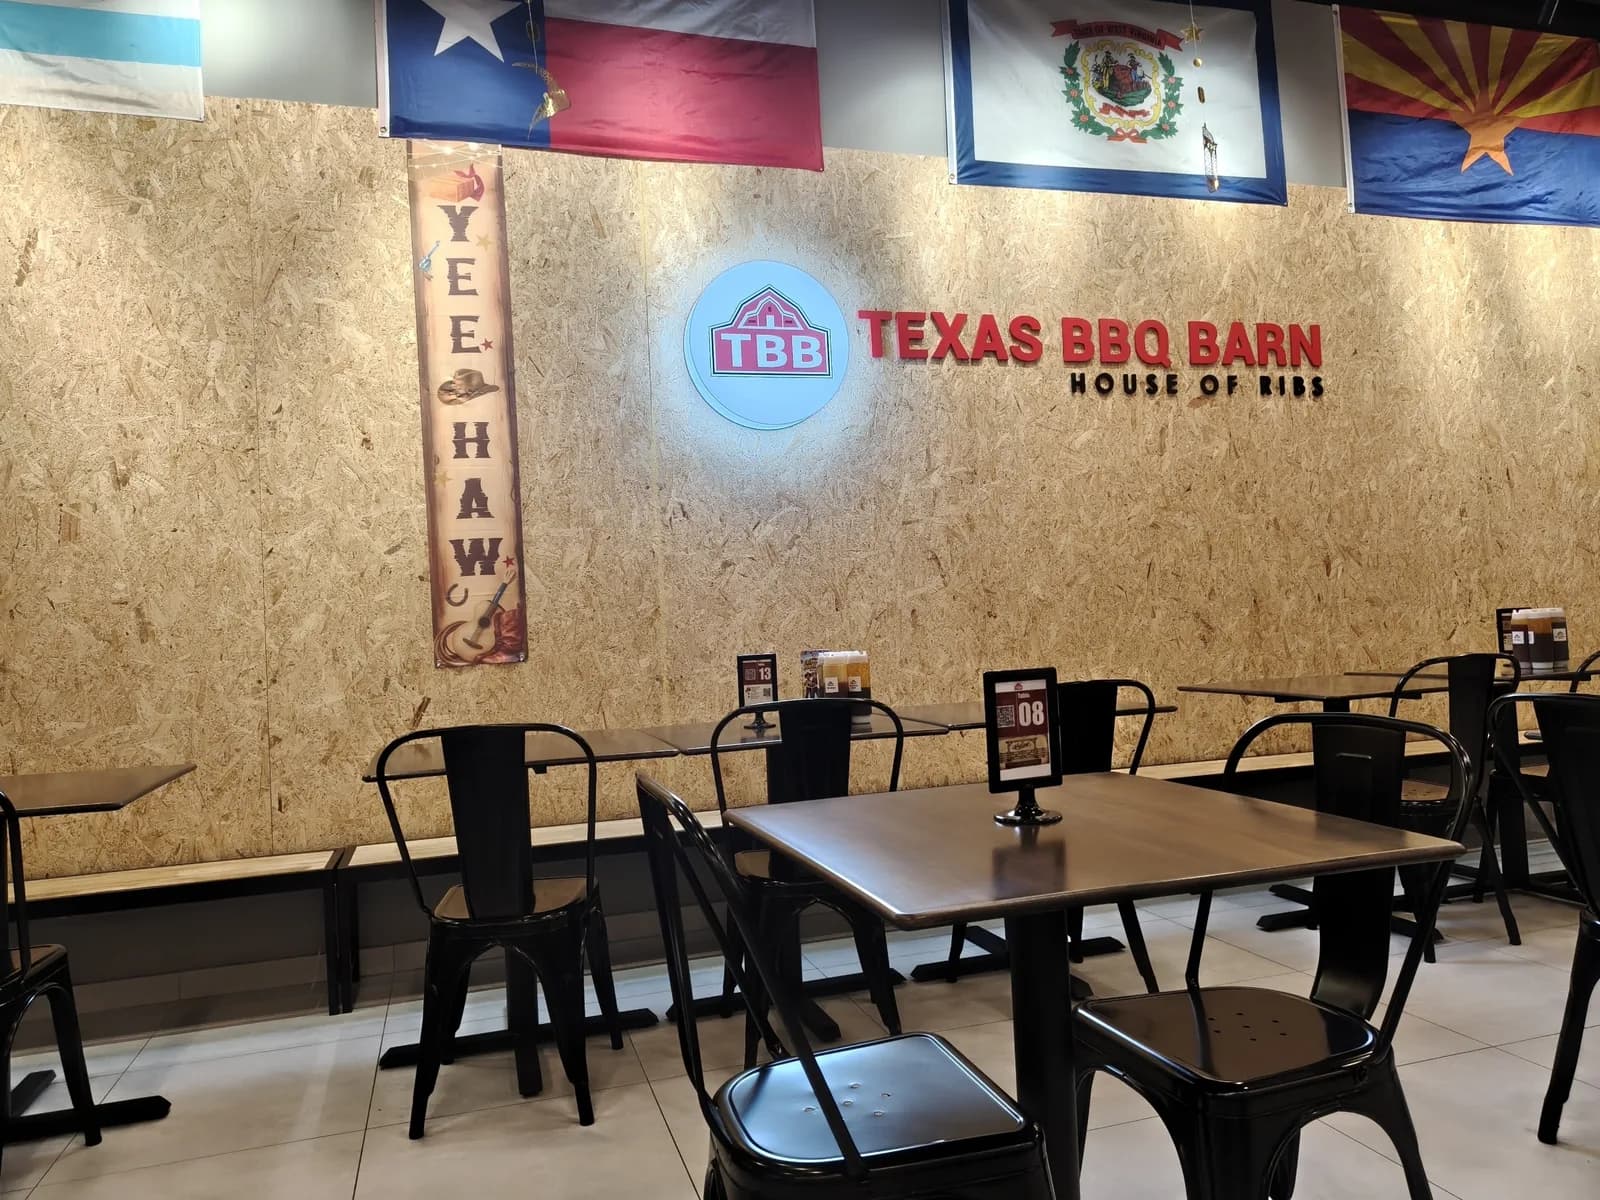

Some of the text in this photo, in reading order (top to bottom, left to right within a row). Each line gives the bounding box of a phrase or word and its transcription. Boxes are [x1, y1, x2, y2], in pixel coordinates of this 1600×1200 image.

[720, 333, 823, 369] TBB
[858, 309, 1322, 368] TEXAS BBQ BARN
[1070, 373, 1324, 397] HOUSE OF RIBS
[759, 667, 772, 680] 13
[1018, 701, 1045, 727] 08
